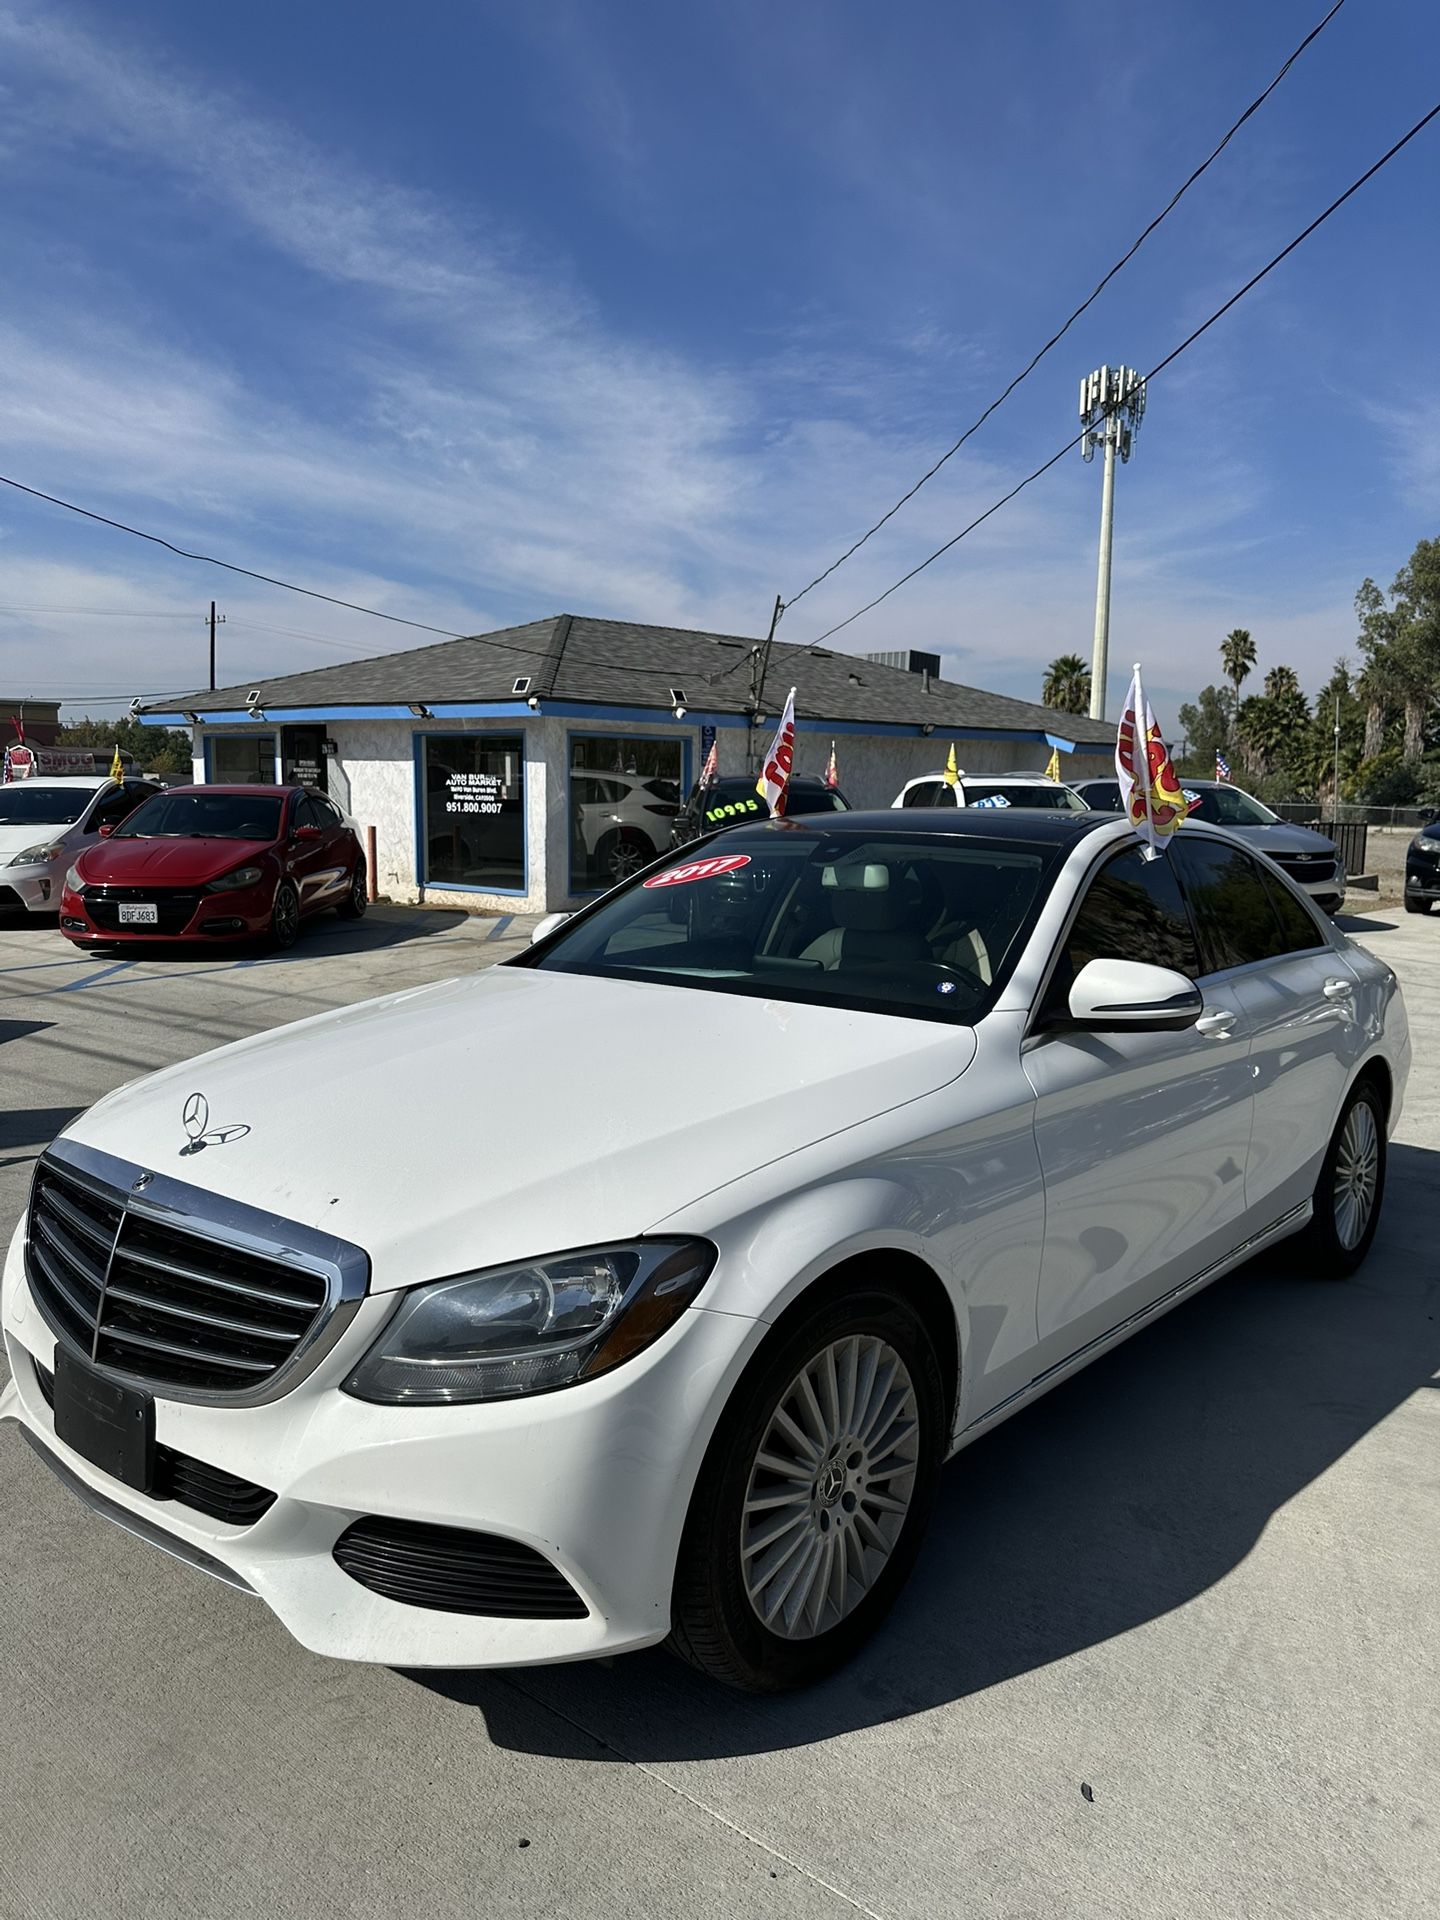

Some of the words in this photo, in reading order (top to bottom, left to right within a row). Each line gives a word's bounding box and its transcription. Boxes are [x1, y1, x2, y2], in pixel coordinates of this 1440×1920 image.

[41, 753, 93, 766] SMOG
[446, 802, 502, 814] 951.800.9007
[706, 800, 757, 821] 10995
[650, 856, 742, 886] 2017
